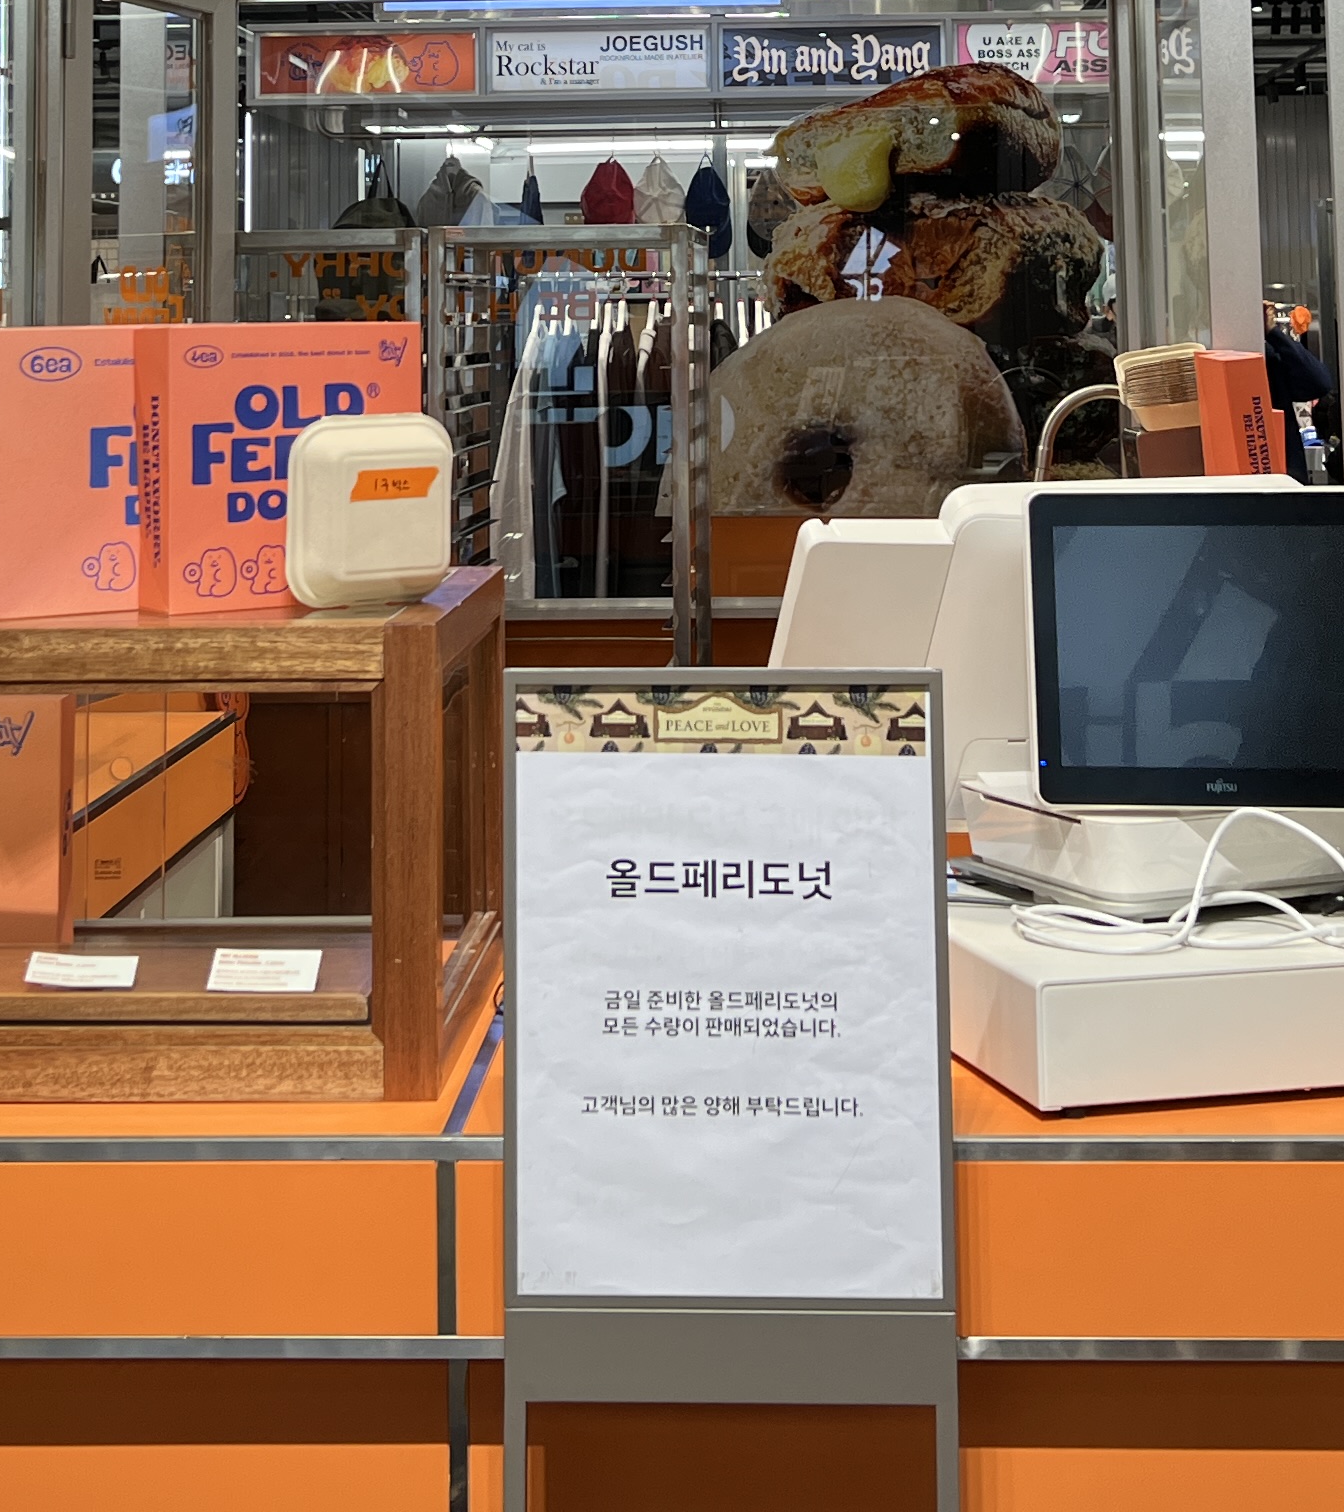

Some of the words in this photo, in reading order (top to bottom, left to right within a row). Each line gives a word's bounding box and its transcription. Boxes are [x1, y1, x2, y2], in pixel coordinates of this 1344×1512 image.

[496, 40, 514, 54] My
[517, 42, 534, 51] cat
[536, 40, 546, 51] is
[600, 34, 704, 52] JOEGUSH
[982, 36, 992, 46] U
[996, 36, 1023, 46] ARE
[1026, 35, 1036, 45] A
[1056, 31, 1109, 57] FU
[795, 36, 844, 75] and
[977, 49, 1013, 59] BOSS
[496, 54, 599, 77] Rockstar
[1053, 59, 1109, 74] ASS
[29, 353, 73, 374] 6ea
[235, 382, 364, 430] OLD
[192, 422, 290, 485] FE
[227, 489, 287, 522] DO
[665, 719, 714, 733] PEACE
[716, 720, 730, 730] and
[731, 719, 771, 733] LOVE
[606, 858, 833, 900] 올드페리도넛
[604, 990, 641, 1010] 금일
[647, 990, 702, 1012] 준비한
[707, 990, 839, 1013] 올드페리도넛의
[602, 1017, 638, 1037] 모든
[644, 1016, 700, 1037] 수량이
[705, 1016, 841, 1038] 판매되었습니다.
[581, 1096, 655, 1116] 고객님의
[661, 1096, 698, 1116] 많은
[703, 1096, 740, 1116] 양해
[746, 1096, 864, 1117] 부탁드립니다.
